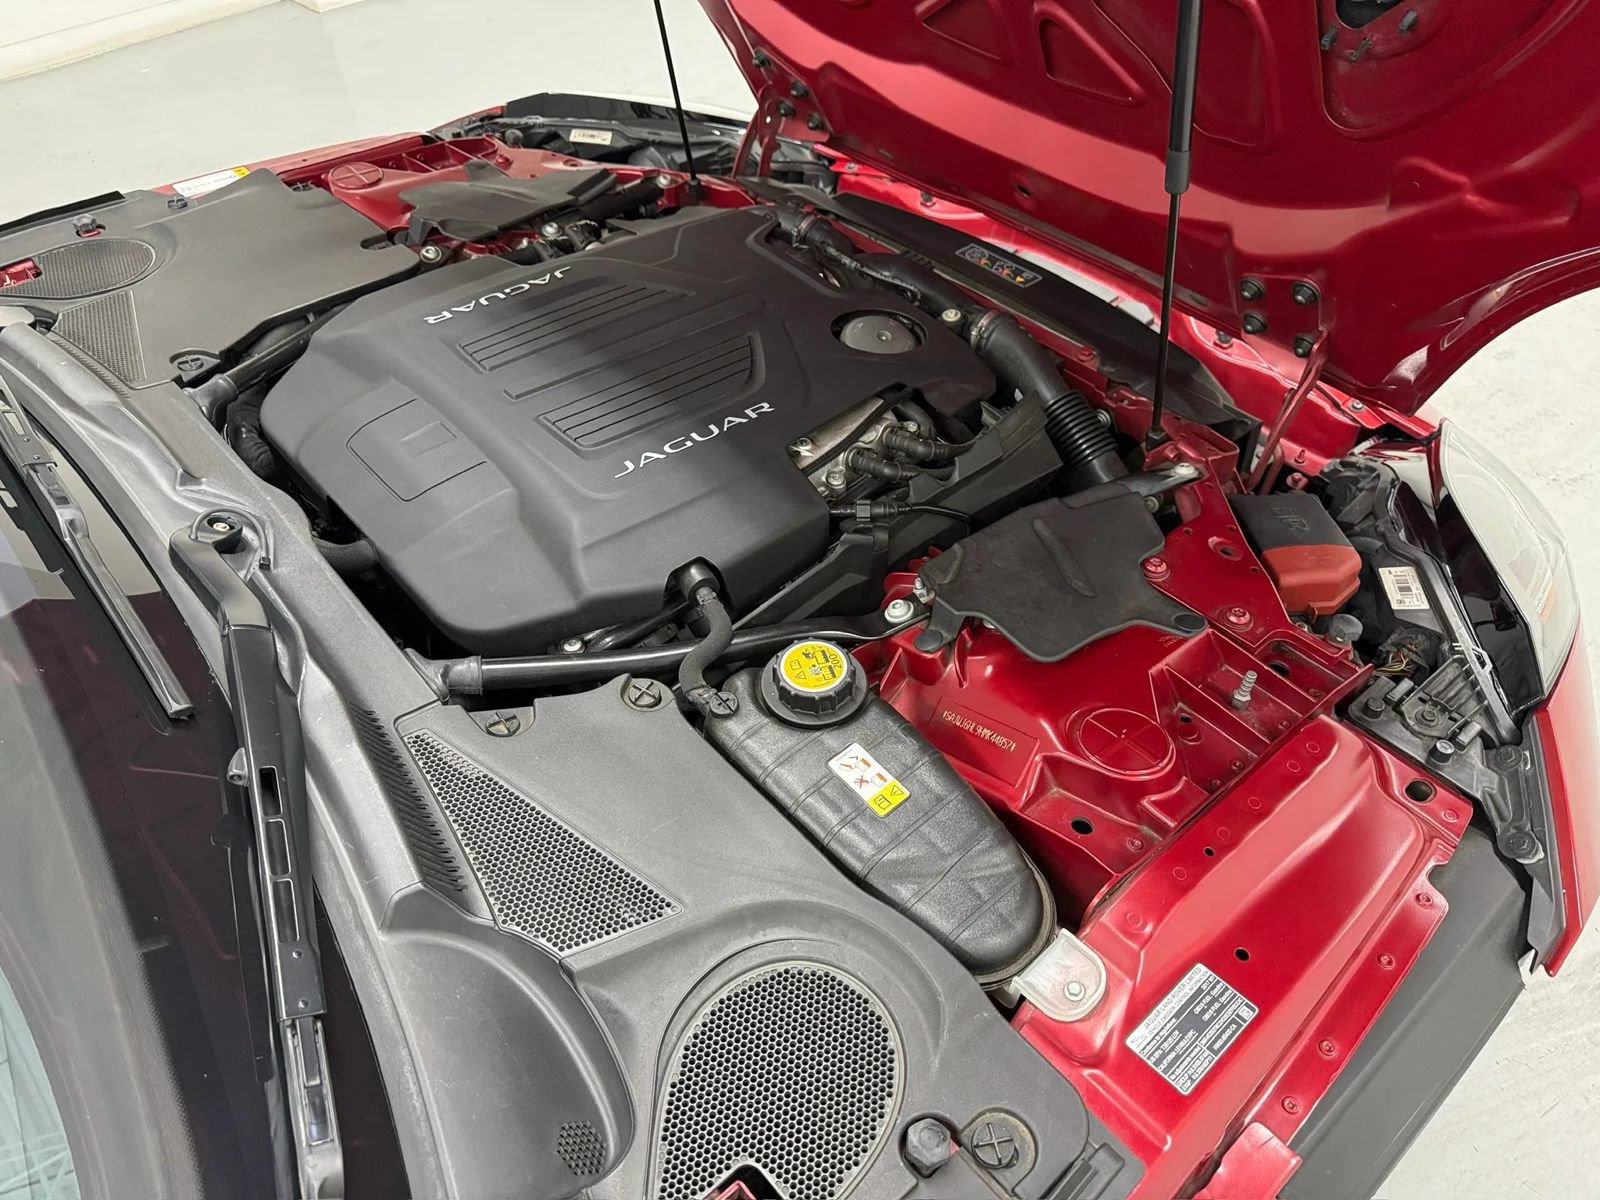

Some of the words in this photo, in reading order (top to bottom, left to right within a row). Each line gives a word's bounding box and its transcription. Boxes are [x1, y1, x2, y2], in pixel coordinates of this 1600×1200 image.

[423, 266, 571, 324] JAGUAR
[614, 402, 775, 478] JAGUAR
[1143, 1010, 1162, 1029] JAGUAR
[1160, 998, 1174, 1011] LAND
[1171, 983, 1187, 999] ROVER
[1185, 967, 1202, 984] LIMITED
[1148, 1021, 1162, 1036] VEHICLE
[1161, 1005, 1177, 1022] EMISSION
[1175, 991, 1190, 1007] CONTROL
[1188, 970, 1209, 992] INFORMATION
[1201, 980, 1211, 990] 2017
